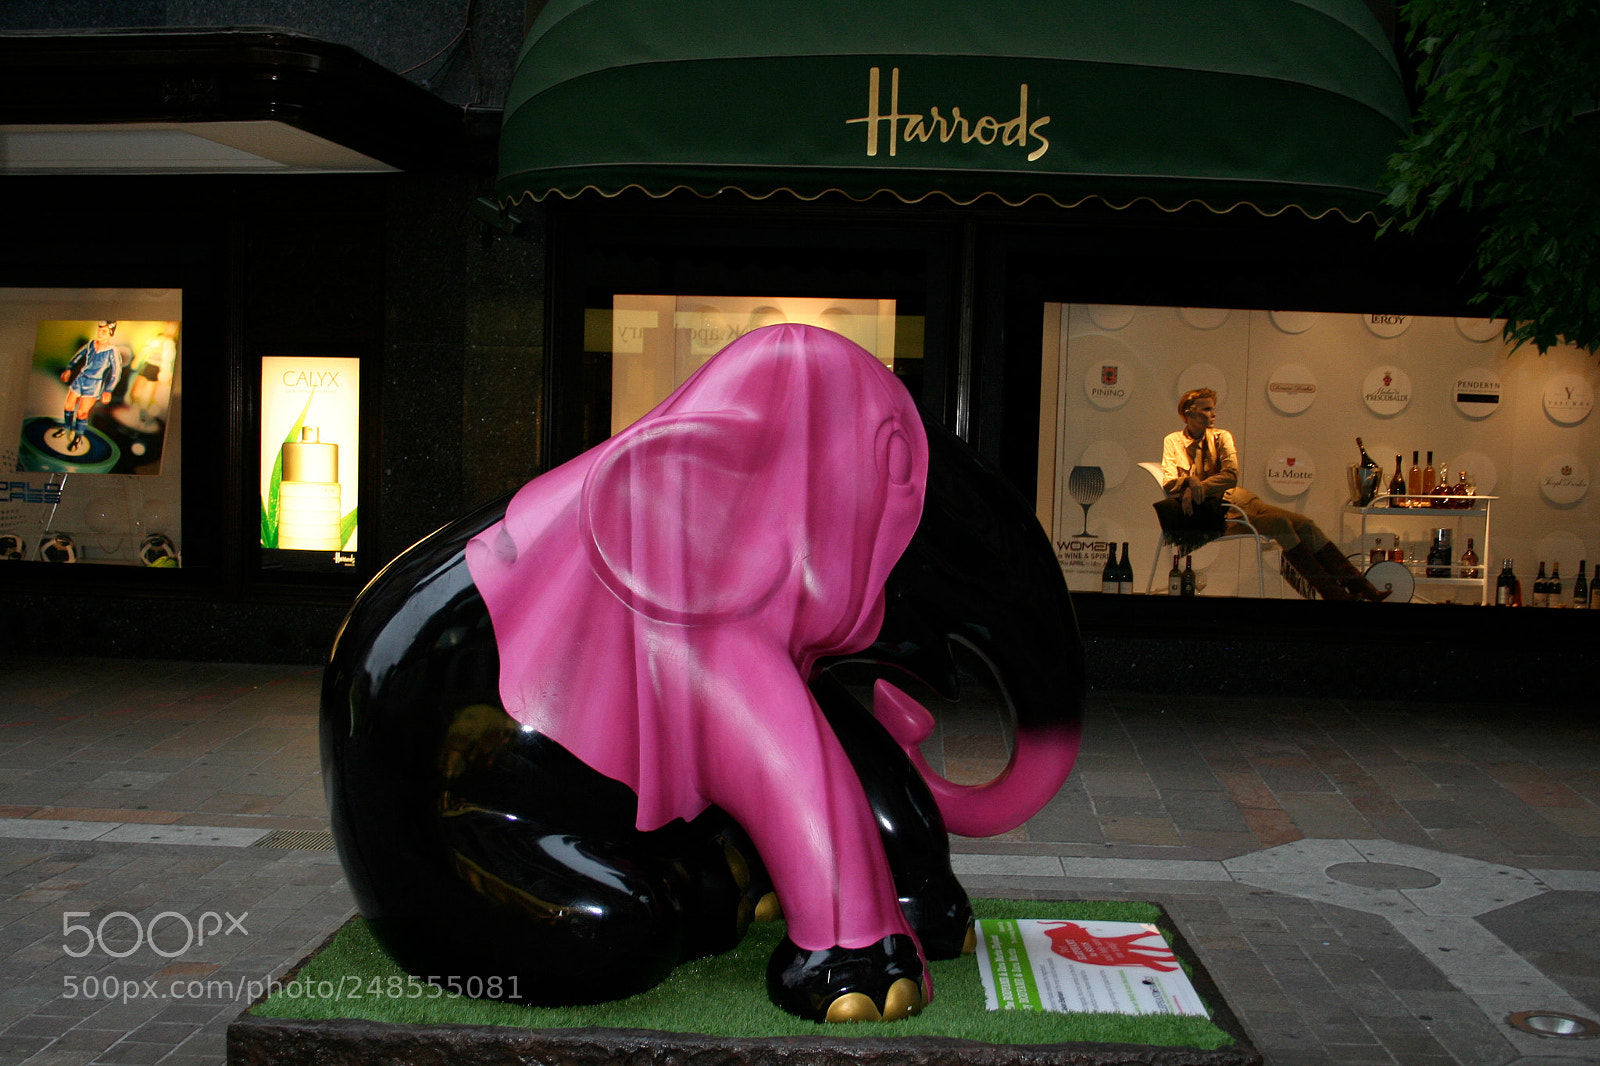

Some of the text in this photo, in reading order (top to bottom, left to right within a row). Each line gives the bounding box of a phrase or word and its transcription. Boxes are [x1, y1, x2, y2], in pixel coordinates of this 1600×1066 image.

[846, 67, 1050, 162] Harrods
[1371, 313, 1406, 325] LEROY
[282, 370, 340, 388] CALYX
[1457, 380, 1500, 389] PENDERYN
[1091, 387, 1125, 397] PININO
[1268, 469, 1313, 479] La Motte
